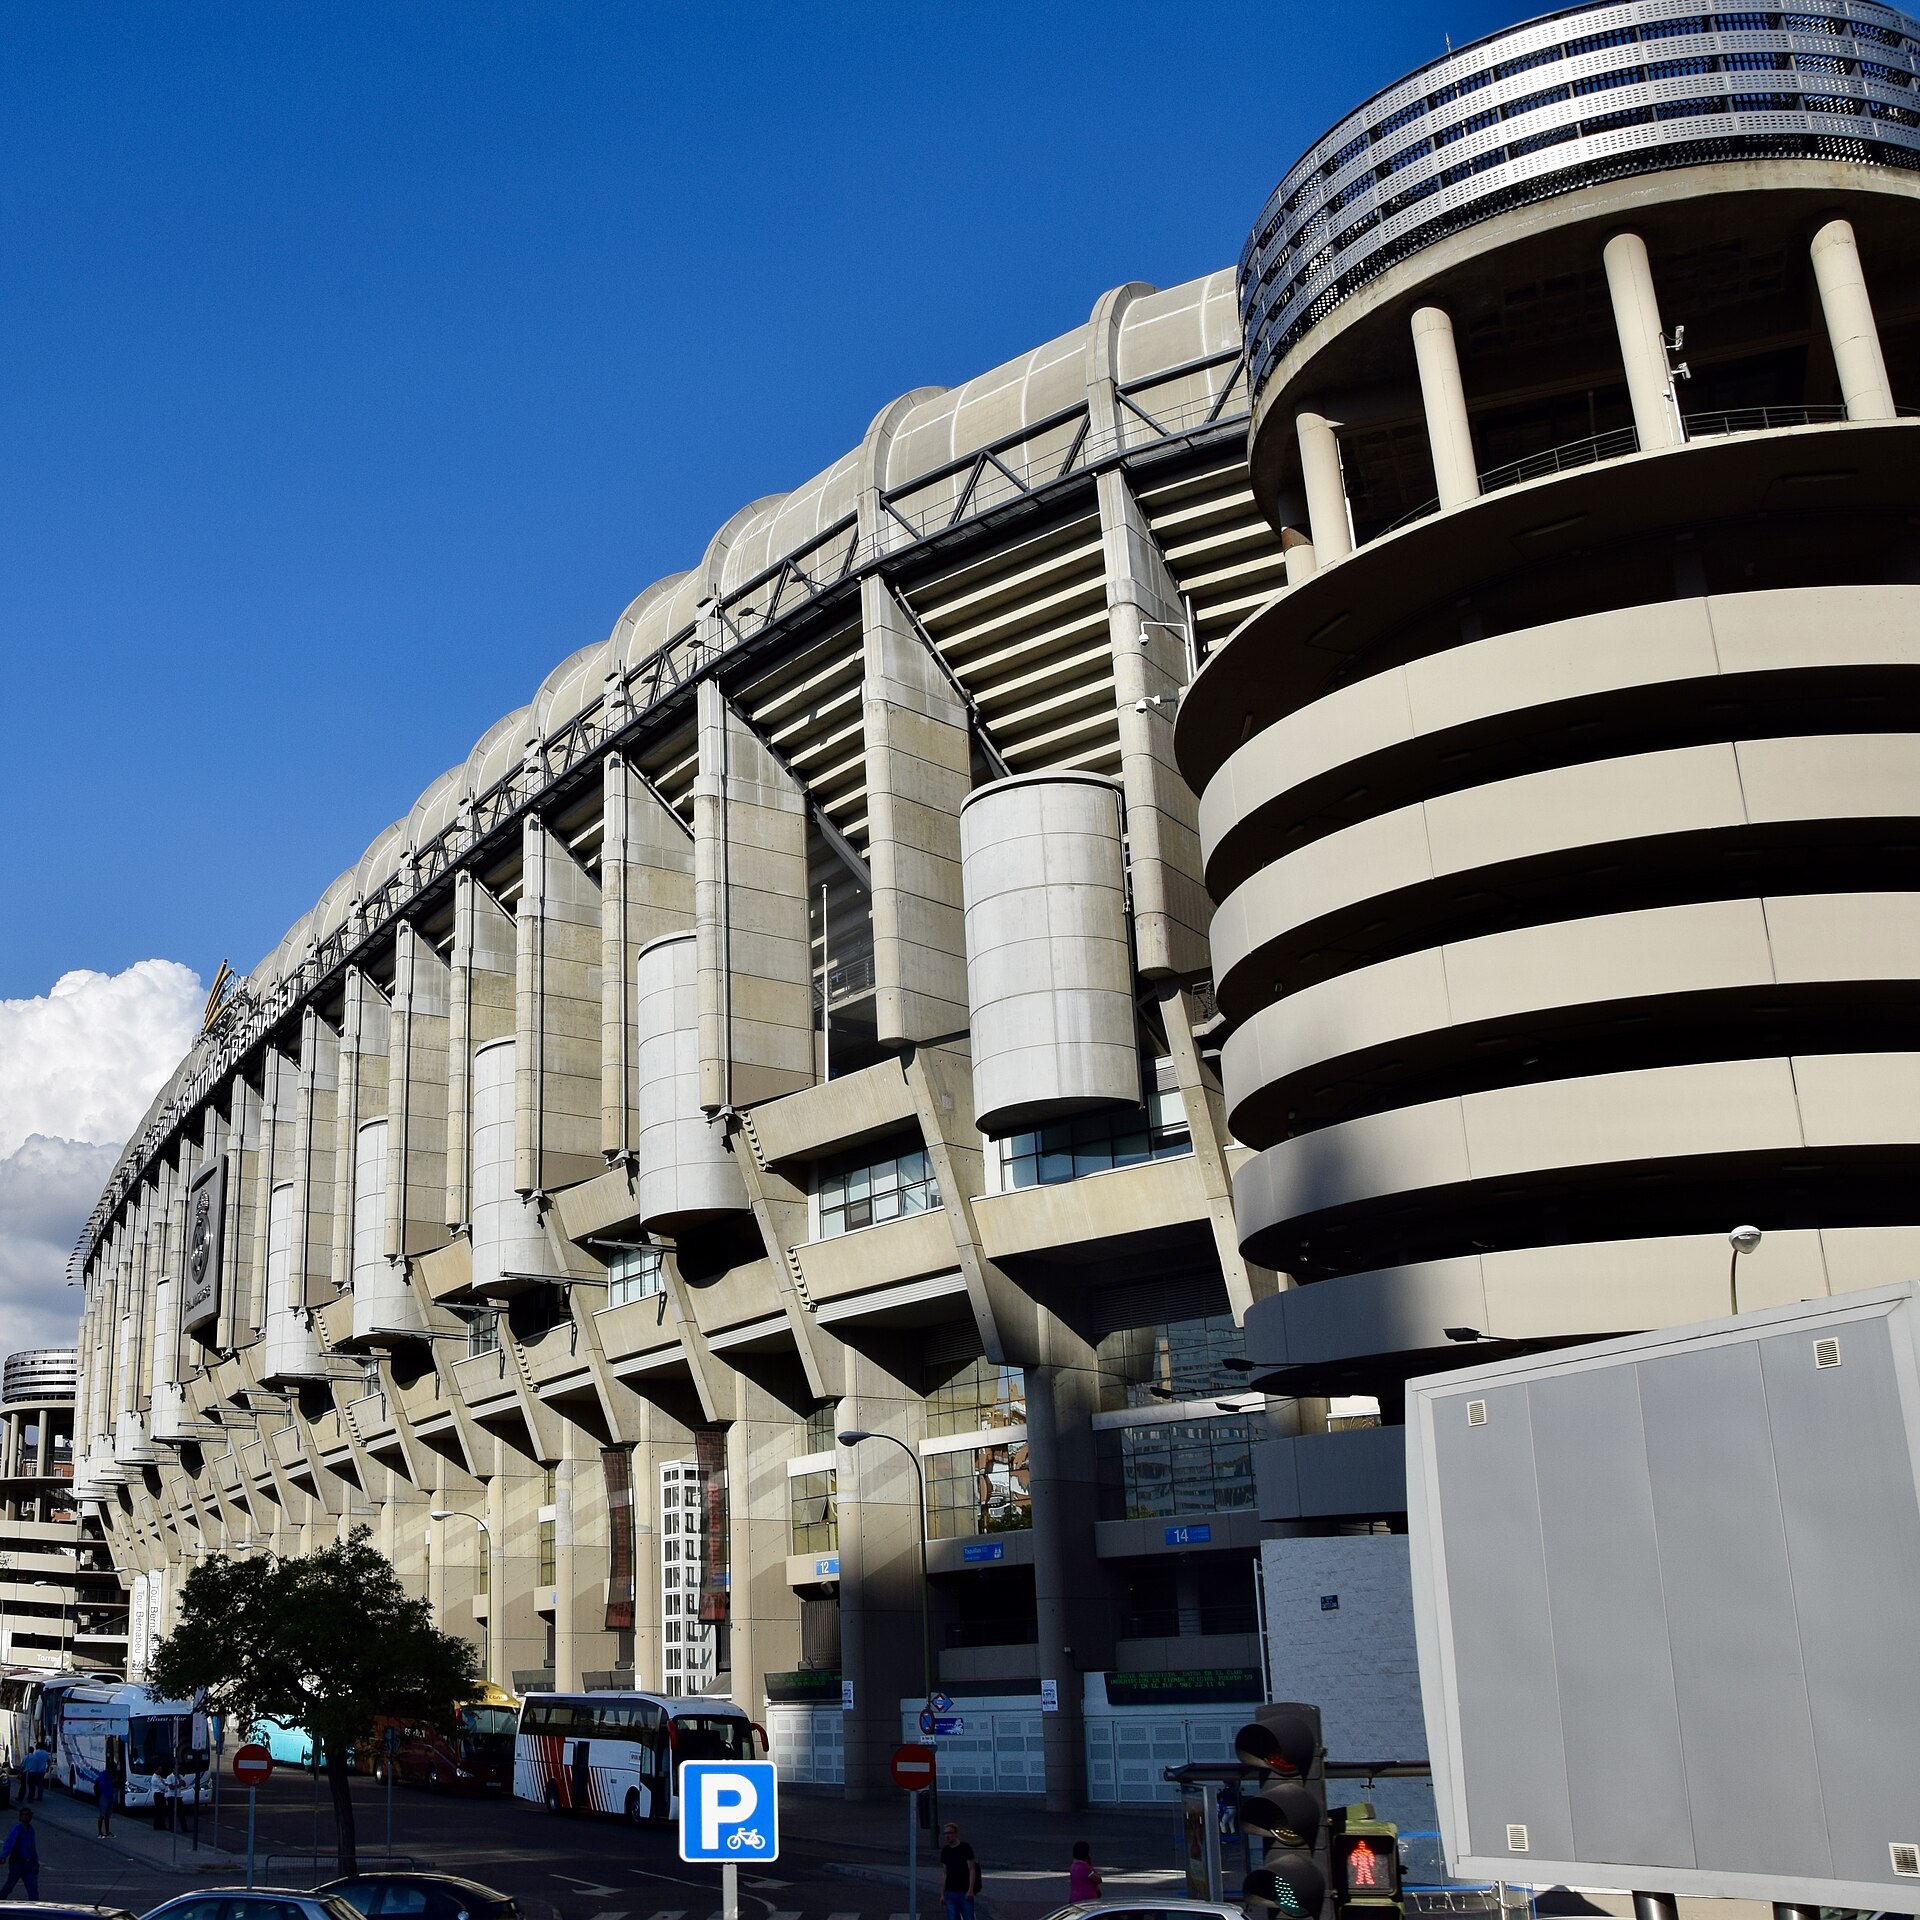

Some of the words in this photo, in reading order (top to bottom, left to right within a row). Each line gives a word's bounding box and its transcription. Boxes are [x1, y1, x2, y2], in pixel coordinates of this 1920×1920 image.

[182, 1049, 230, 1118] SANTIAGO
[1173, 1528, 1189, 1543] 14
[820, 1560, 829, 1574] 12
[137, 1590, 145, 1610] Tour
[150, 1586, 158, 1605] Tour
[701, 1773, 758, 1850] P
